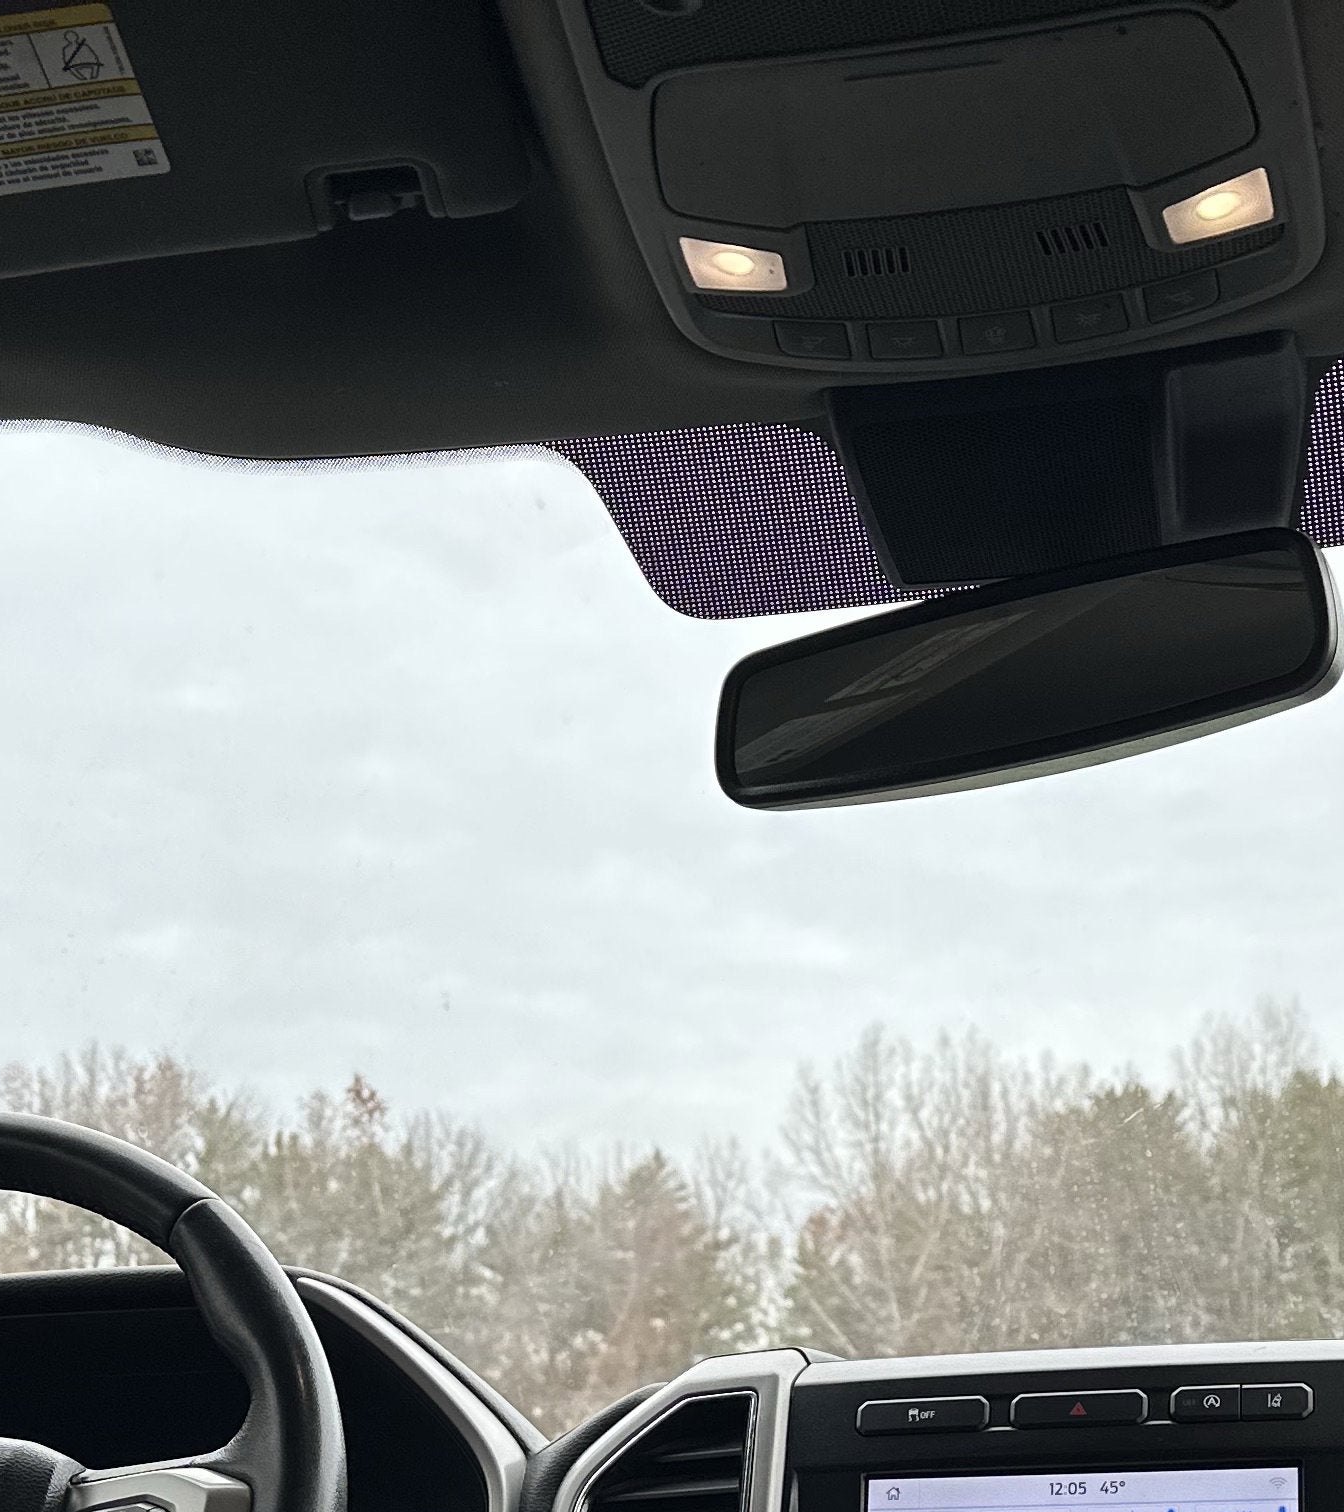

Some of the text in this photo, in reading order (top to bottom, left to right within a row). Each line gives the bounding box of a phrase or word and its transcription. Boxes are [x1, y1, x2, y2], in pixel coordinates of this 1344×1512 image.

[920, 1410, 936, 1420] OFF
[1049, 1480, 1126, 1496] 12:05 45°
